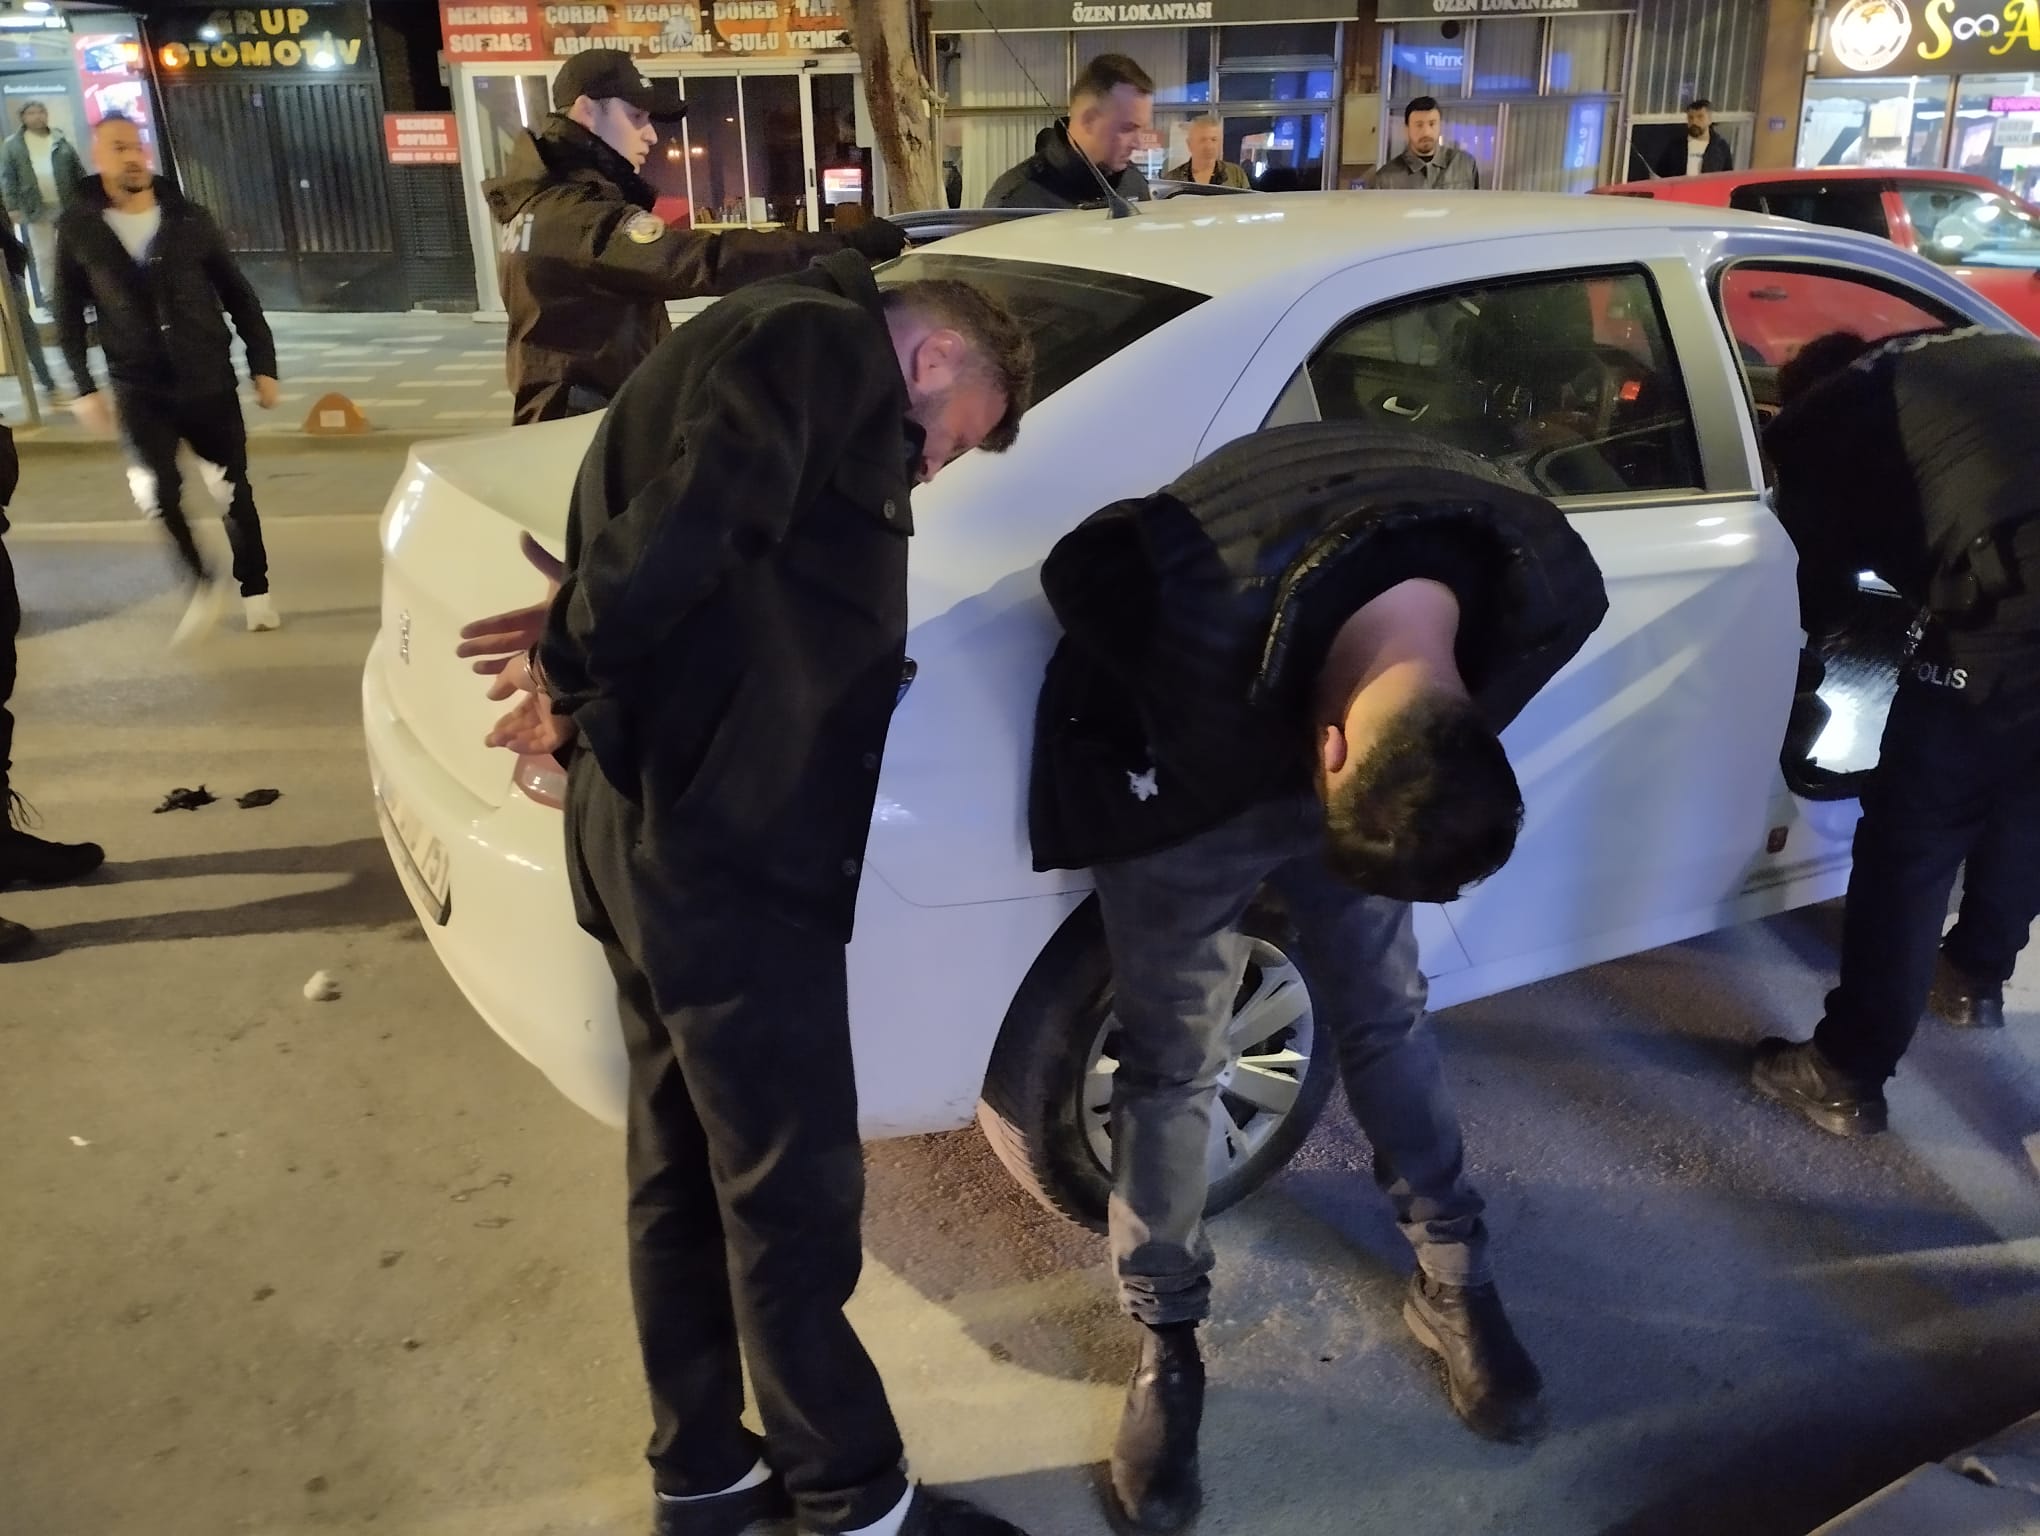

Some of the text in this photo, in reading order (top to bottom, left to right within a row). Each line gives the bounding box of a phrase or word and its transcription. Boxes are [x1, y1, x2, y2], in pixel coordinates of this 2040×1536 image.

[207, 8, 309, 35] GRUP
[545, 5, 609, 29] ÇORBA
[1072, 2, 1213, 23] ÖZEN LOKANTASI
[729, 32, 779, 51] SULU
